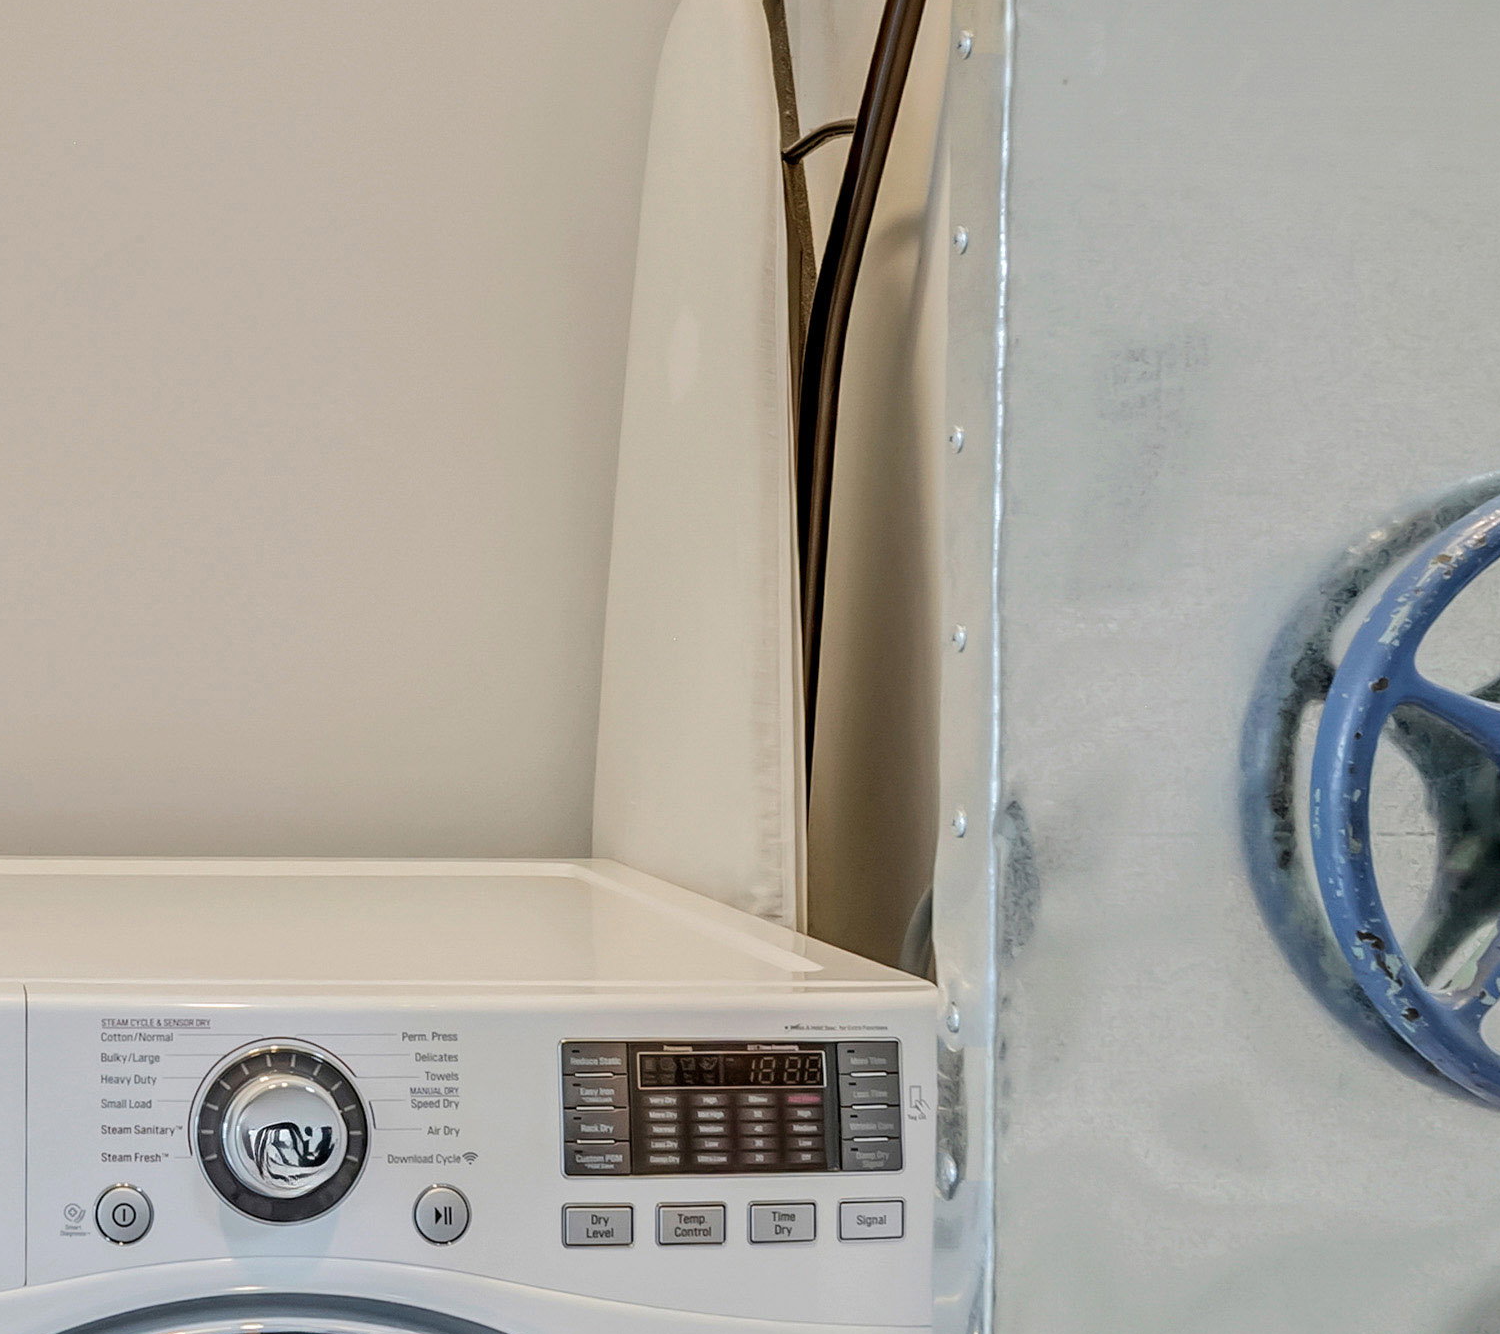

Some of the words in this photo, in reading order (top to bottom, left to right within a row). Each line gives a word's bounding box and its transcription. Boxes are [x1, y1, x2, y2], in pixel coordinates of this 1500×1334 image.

[101, 1019, 129, 1027] STEAM
[130, 1019, 154, 1027] CYCLE
[163, 1019, 194, 1027] SENSOR
[195, 1019, 211, 1027] DRY
[100, 1032, 174, 1042] Cotton/Normal
[431, 1032, 458, 1042] Press
[100, 1053, 160, 1065] Bulky/Large
[414, 1052, 459, 1062] Delicates
[100, 1075, 132, 1085] Heavy
[134, 1074, 157, 1085] Duty
[424, 1071, 459, 1081] Towels
[409, 1087, 442, 1095] MANUAL
[101, 1098, 127, 1109] Small
[129, 1099, 152, 1109] Load
[410, 1099, 440, 1110] Speed
[443, 1099, 460, 1110] Dry
[101, 1125, 131, 1135] Steam
[427, 1126, 441, 1136] Air
[443, 1126, 460, 1137] Dry
[600, 1124, 614, 1134] Dry
[101, 1153, 131, 1162] Steam
[387, 1153, 433, 1164] Download
[435, 1153, 461, 1166] Cycle
[591, 1214, 610, 1226] Dry
[771, 1211, 796, 1222] Time
[856, 1215, 887, 1227] Signal
[586, 1228, 614, 1238] Level
[674, 1227, 712, 1237] Control
[774, 1224, 793, 1236] Dry
